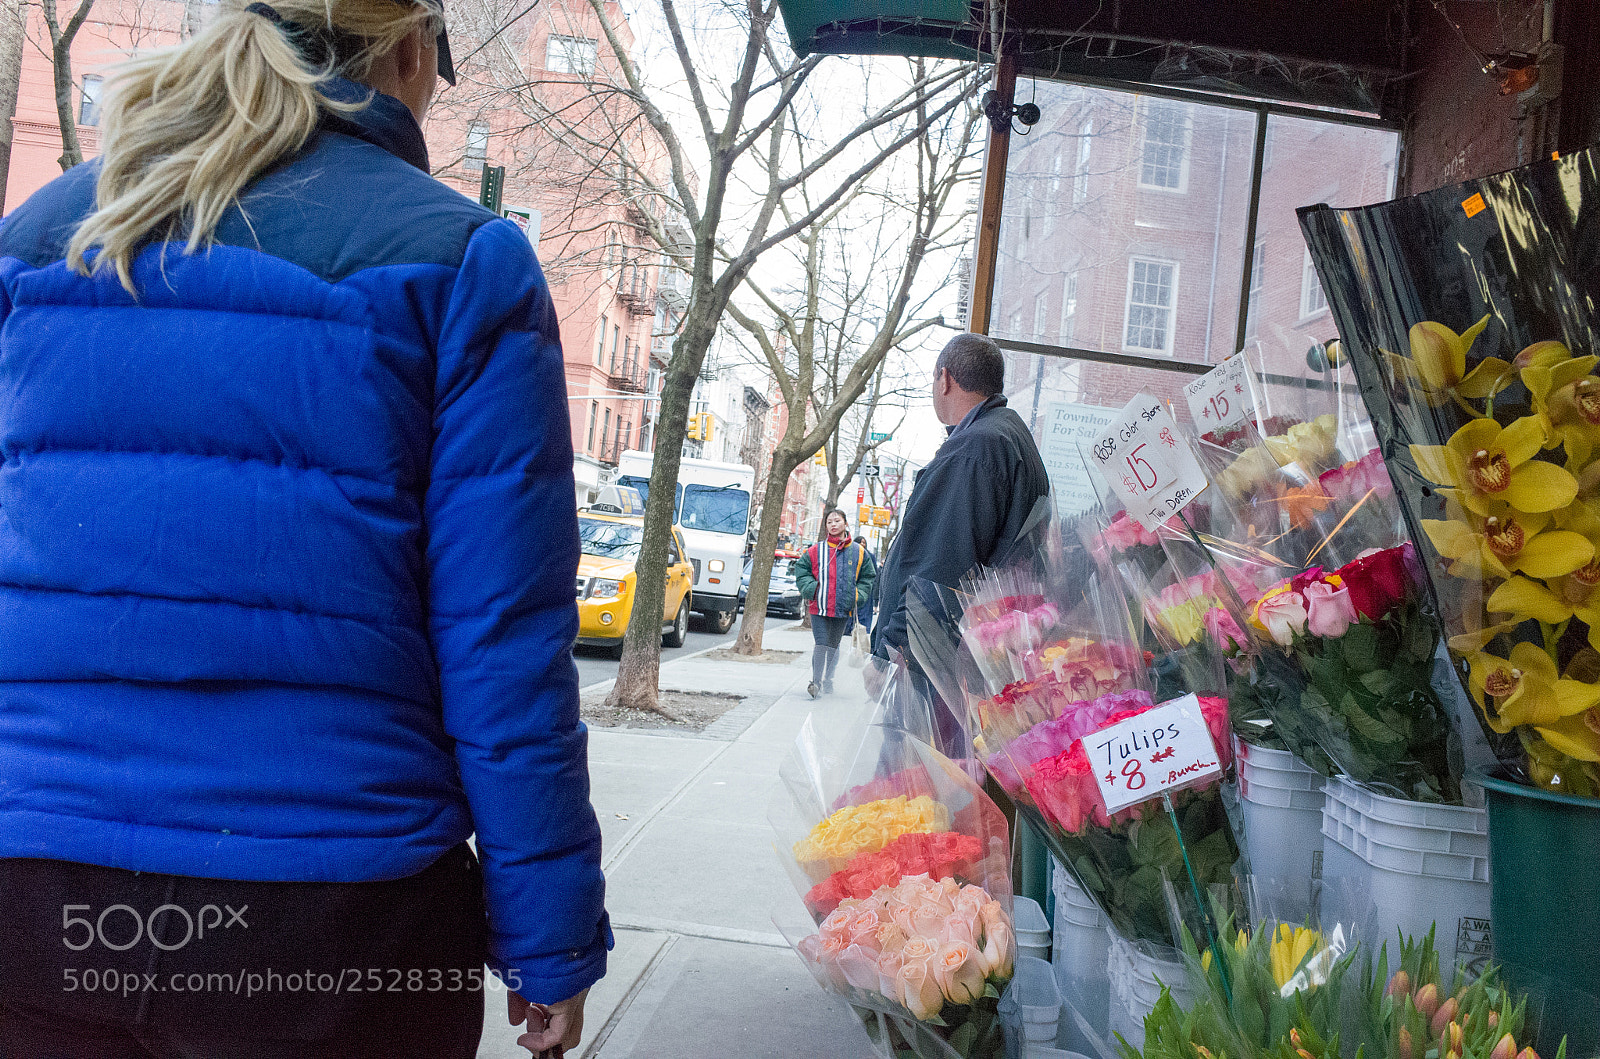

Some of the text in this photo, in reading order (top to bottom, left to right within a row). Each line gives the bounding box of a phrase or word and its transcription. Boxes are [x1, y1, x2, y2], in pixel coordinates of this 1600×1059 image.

[1052, 424, 1099, 439] For Sal
[1097, 723, 1180, 765] Tulips
